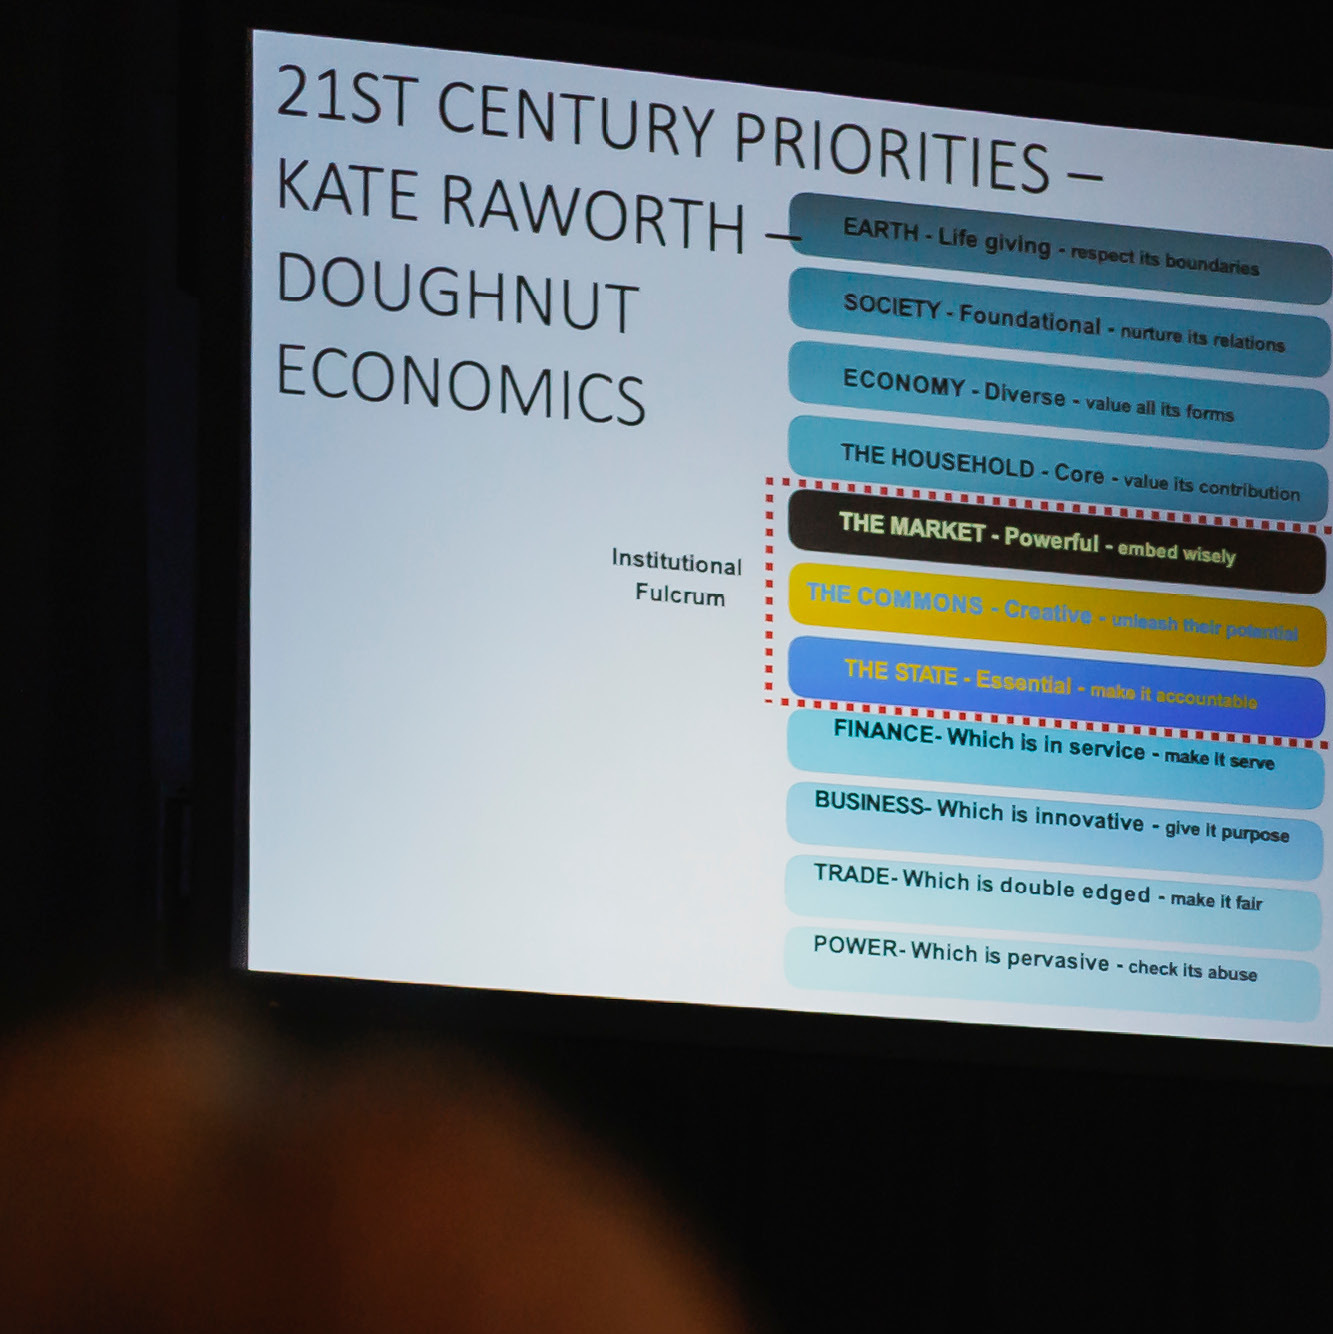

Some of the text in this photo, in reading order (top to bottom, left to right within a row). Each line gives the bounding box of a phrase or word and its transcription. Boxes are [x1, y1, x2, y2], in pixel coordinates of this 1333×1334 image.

[277, 64, 420, 127] 21ST
[438, 81, 715, 158] CENTURY
[737, 112, 1050, 195] PRIORITIES
[279, 157, 419, 222] KATE
[444, 174, 743, 255] RAWORTH
[843, 216, 919, 242] EARTH
[938, 226, 978, 248] Life
[984, 233, 1051, 261] giving
[1071, 245, 1135, 266] respect
[1140, 252, 1161, 267] its
[1165, 252, 1261, 277] boundaries
[279, 251, 640, 334] DOUGHNUT
[843, 293, 942, 320] SOCIETY
[959, 303, 1101, 335] Foundational
[1120, 326, 1183, 344] nurture
[1188, 331, 1208, 346] its
[1213, 333, 1286, 353] relations
[279, 343, 646, 427] ECONOMICS
[843, 368, 966, 397] ECONOMY
[985, 381, 1066, 408] Diverse
[1086, 396, 1132, 414] value
[1136, 400, 1156, 416] all
[1161, 400, 1181, 417] its
[1186, 403, 1235, 423] forms
[840, 442, 885, 465] THE
[891, 447, 1035, 478] HOUSEHOLD
[1054, 462, 1105, 485] Core
[1124, 474, 1169, 491] value
[1174, 476, 1194, 493] its
[1198, 482, 1301, 502] contribution
[612, 547, 742, 576] Institutional
[838, 510, 885, 535] THE
[890, 515, 987, 543] MARKET
[1004, 526, 1099, 553] Powerful
[1117, 541, 1178, 560] embed
[1182, 546, 1237, 569] wisely
[636, 582, 725, 607] Fulcrum
[806, 581, 852, 605] THE
[857, 586, 984, 616] COMMONS
[1004, 599, 1093, 625] Creative
[1112, 613, 1179, 631] unleash
[1183, 616, 1220, 637] their
[1225, 622, 1299, 644] potential
[844, 658, 889, 680] THE
[895, 662, 958, 686] STATE
[976, 669, 1072, 695] Essential
[1090, 682, 1136, 701] make
[1141, 686, 1152, 702] it
[1156, 690, 1259, 710] accountable
[834, 718, 943, 744] FINANCE-
[946, 727, 1015, 750] Which
[1021, 732, 1038, 752] is
[1044, 734, 1063, 754] in
[1069, 740, 1146, 761] service
[1164, 749, 1210, 766] make
[1214, 751, 1226, 767] it
[1229, 756, 1276, 771] serve
[815, 789, 932, 816] BUSINESS-
[937, 799, 1004, 821] Which
[1011, 804, 1028, 824] is
[1035, 806, 1144, 833] innovative
[1165, 820, 1201, 839] give
[1205, 823, 1217, 838] it
[1221, 827, 1290, 845] purpose
[813, 862, 898, 886] TRADE-
[902, 868, 969, 891] Which
[977, 874, 994, 893] is
[1000, 876, 1075, 898] double
[1082, 883, 1150, 906] edged
[1170, 892, 1216, 908] make
[1220, 894, 1232, 910] it
[1235, 895, 1263, 911] fair
[814, 934, 906, 957] POWER-
[911, 941, 977, 963] Which
[985, 946, 1001, 965] is
[1008, 948, 1110, 974] pervasive
[1128, 959, 1179, 977] check
[1183, 962, 1203, 979] its
[1207, 964, 1258, 983] abuse
